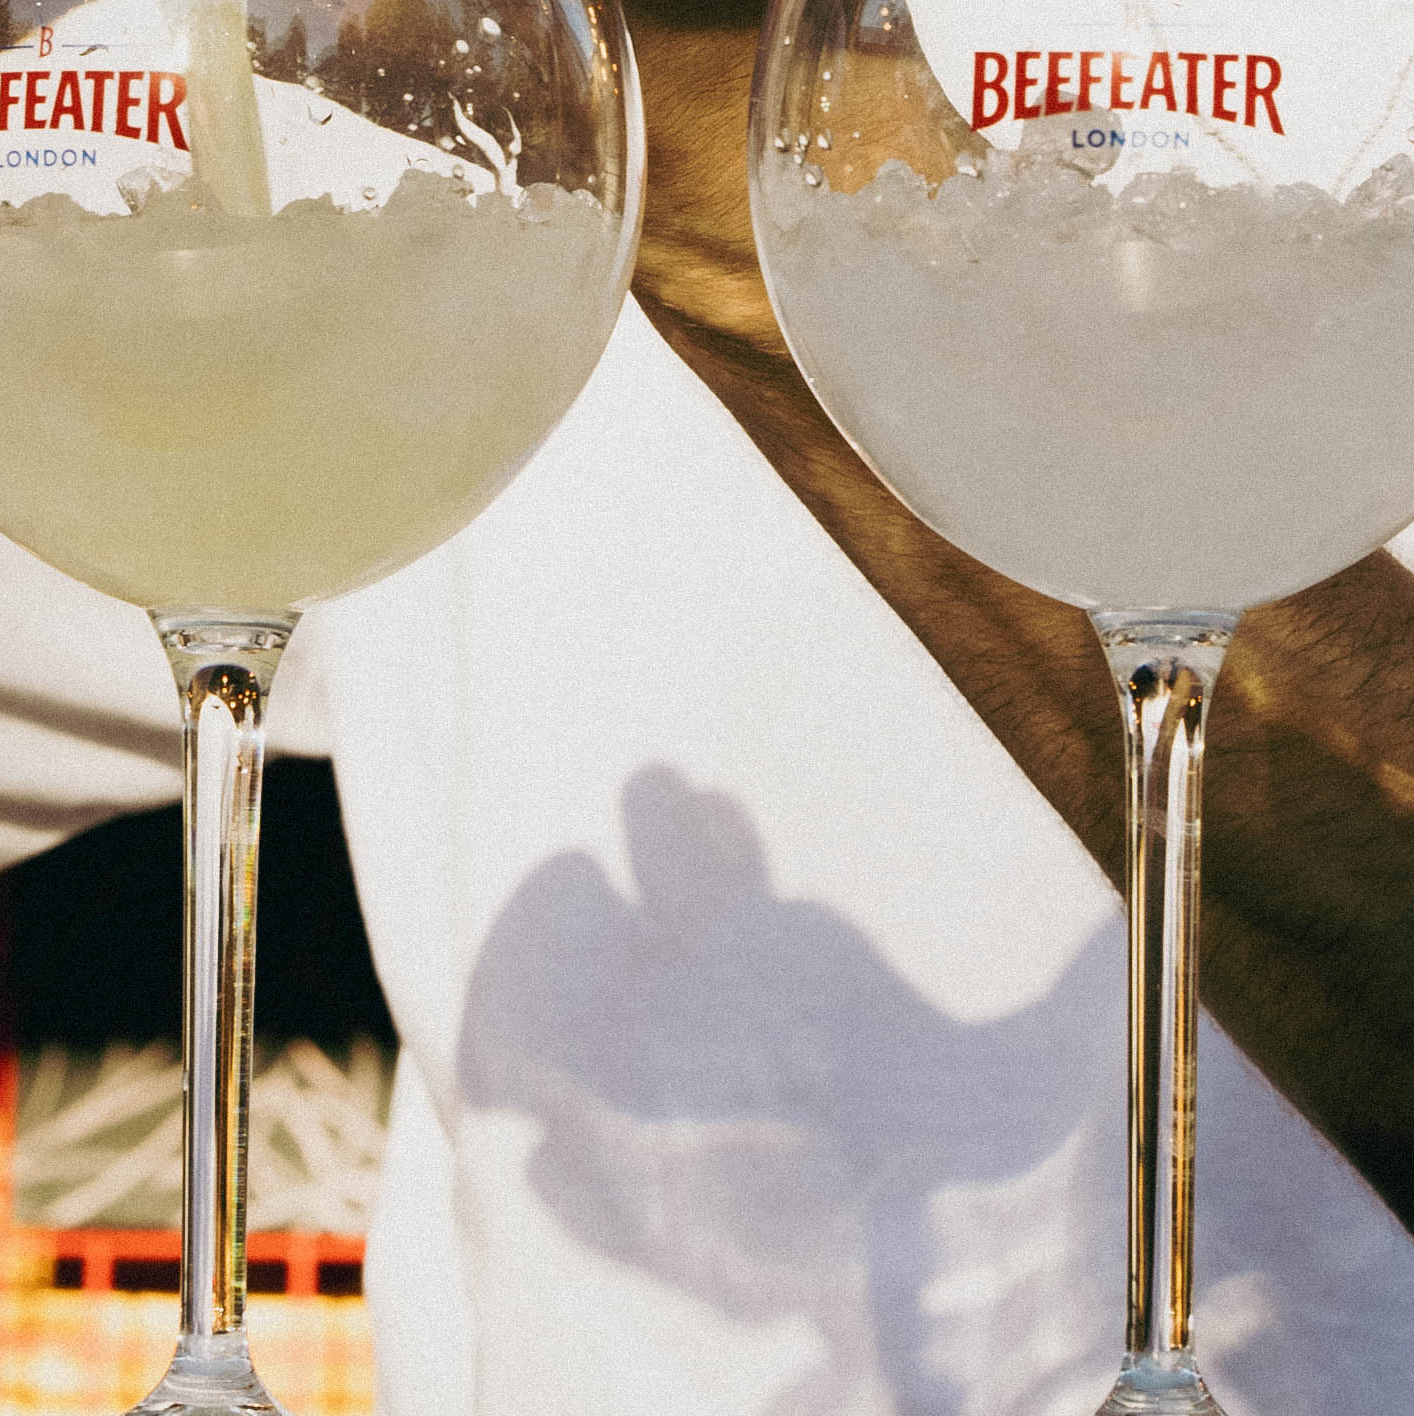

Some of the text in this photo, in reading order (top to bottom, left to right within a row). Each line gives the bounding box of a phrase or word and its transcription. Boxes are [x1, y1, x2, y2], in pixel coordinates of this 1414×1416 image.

[38, 25, 54, 58] B
[970, 50, 1286, 136] BEEFEATER
[1071, 128, 1189, 149] LONDON
